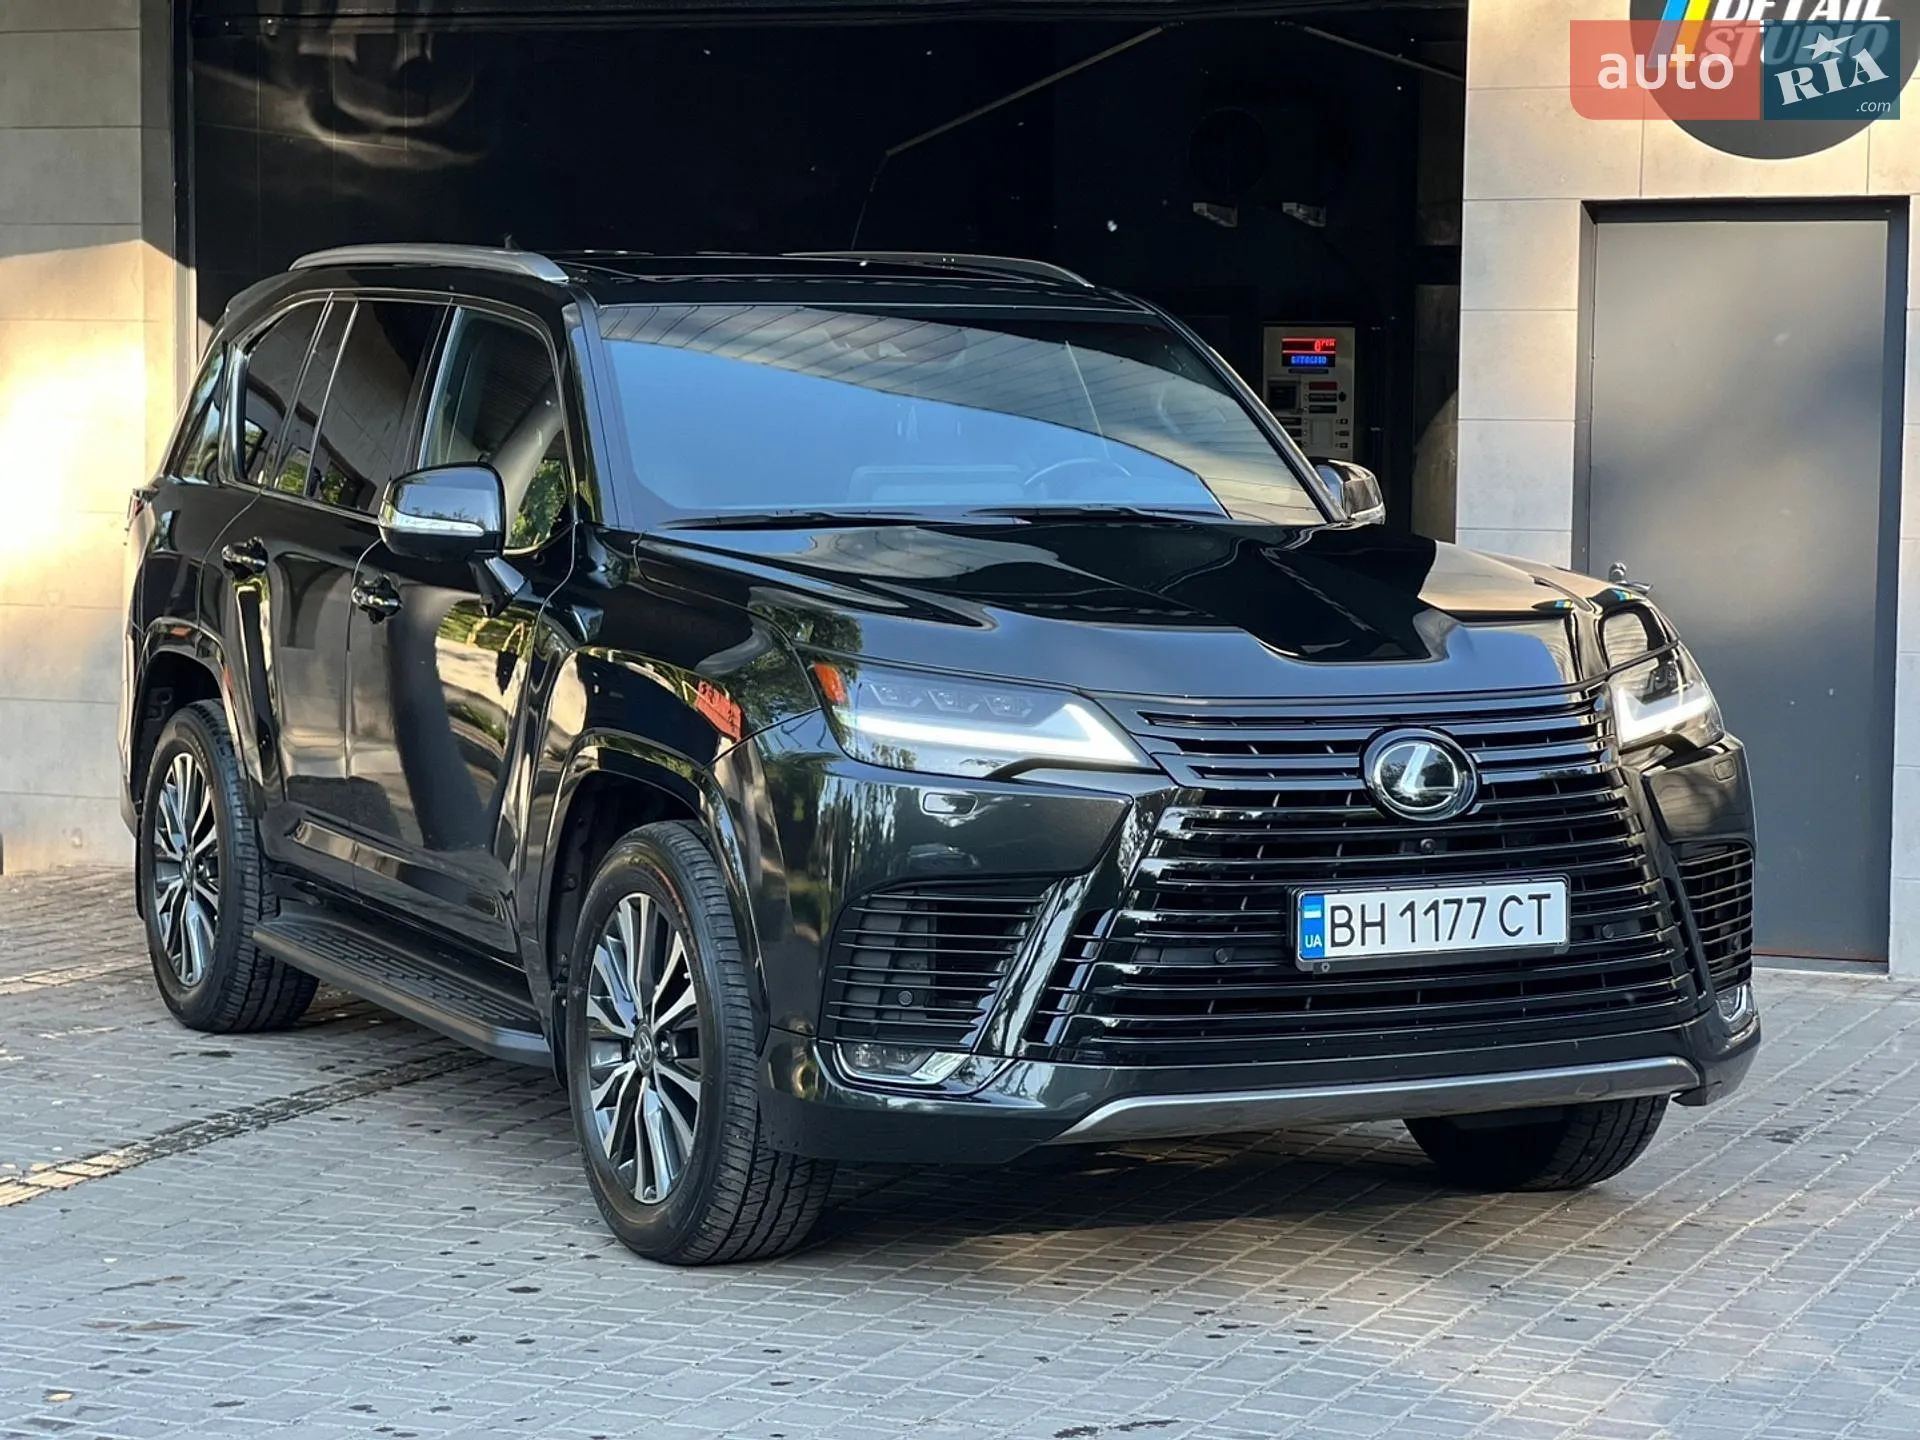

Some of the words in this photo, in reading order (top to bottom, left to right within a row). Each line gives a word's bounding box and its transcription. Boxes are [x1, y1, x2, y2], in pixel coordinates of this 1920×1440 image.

[1711, 0, 1891, 27] DETAIL
[1699, 24, 1890, 66] STUDIO
[1330, 903, 1386, 948] BH
[1399, 897, 1487, 943] 1177
[1499, 894, 1551, 937] CT
[1305, 934, 1322, 948] UA
